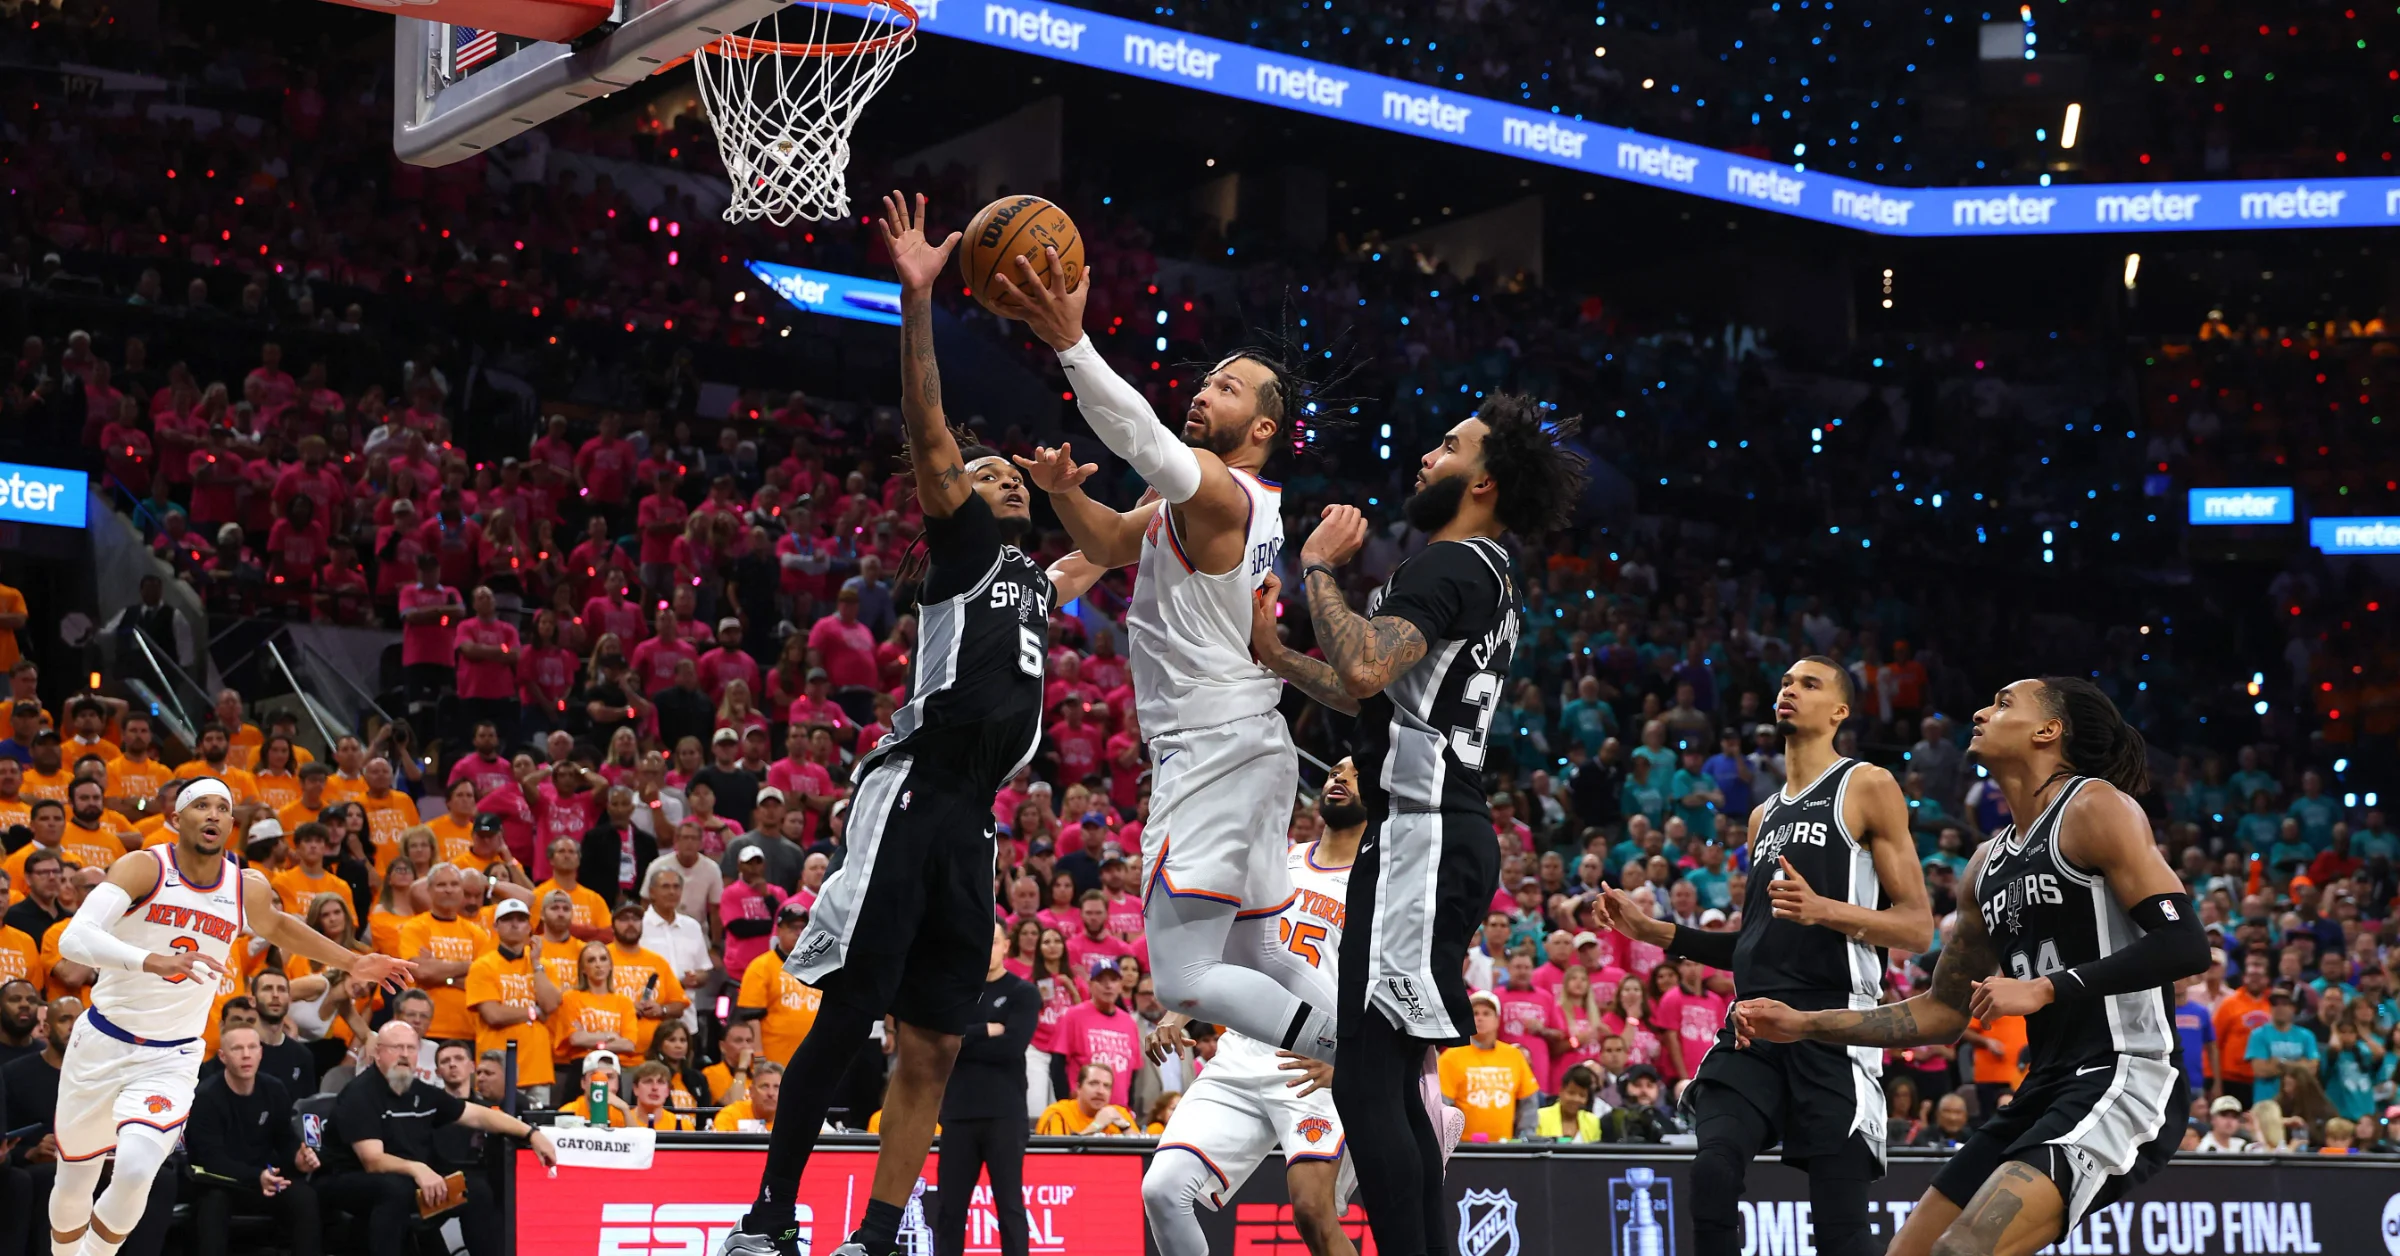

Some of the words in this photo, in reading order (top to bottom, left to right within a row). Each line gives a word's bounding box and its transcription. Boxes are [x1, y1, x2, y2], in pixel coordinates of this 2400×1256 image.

[986, 4, 1087, 50] meter
[1125, 34, 1221, 80] meter
[1256, 63, 1349, 107] meter
[1384, 91, 1471, 133] meter
[1503, 117, 1588, 158] meter
[1618, 143, 1698, 182] meter
[1728, 167, 1805, 205] meter
[2096, 189, 2200, 222] meter
[2240, 186, 2345, 219] meter
[1833, 189, 1913, 226] meter
[1953, 193, 2056, 225] meter
[0, 472, 64, 512] ter
[2204, 492, 2279, 517] meter
[2336, 522, 2400, 547] mete
[990, 581, 1049, 622] SPUR
[1018, 624, 1044, 679] 5
[1448, 670, 1505, 771] 3
[145, 903, 193, 929] NEW
[191, 909, 238, 945] YORK
[592, 1089, 604, 1103] G
[557, 1138, 631, 1153] GATORADE
[1037, 1185, 1075, 1206] CUP
[1472, 1210, 1508, 1255] NHL
[2141, 1201, 2217, 1256] CUP
[2221, 1201, 2322, 1256] FINAL
